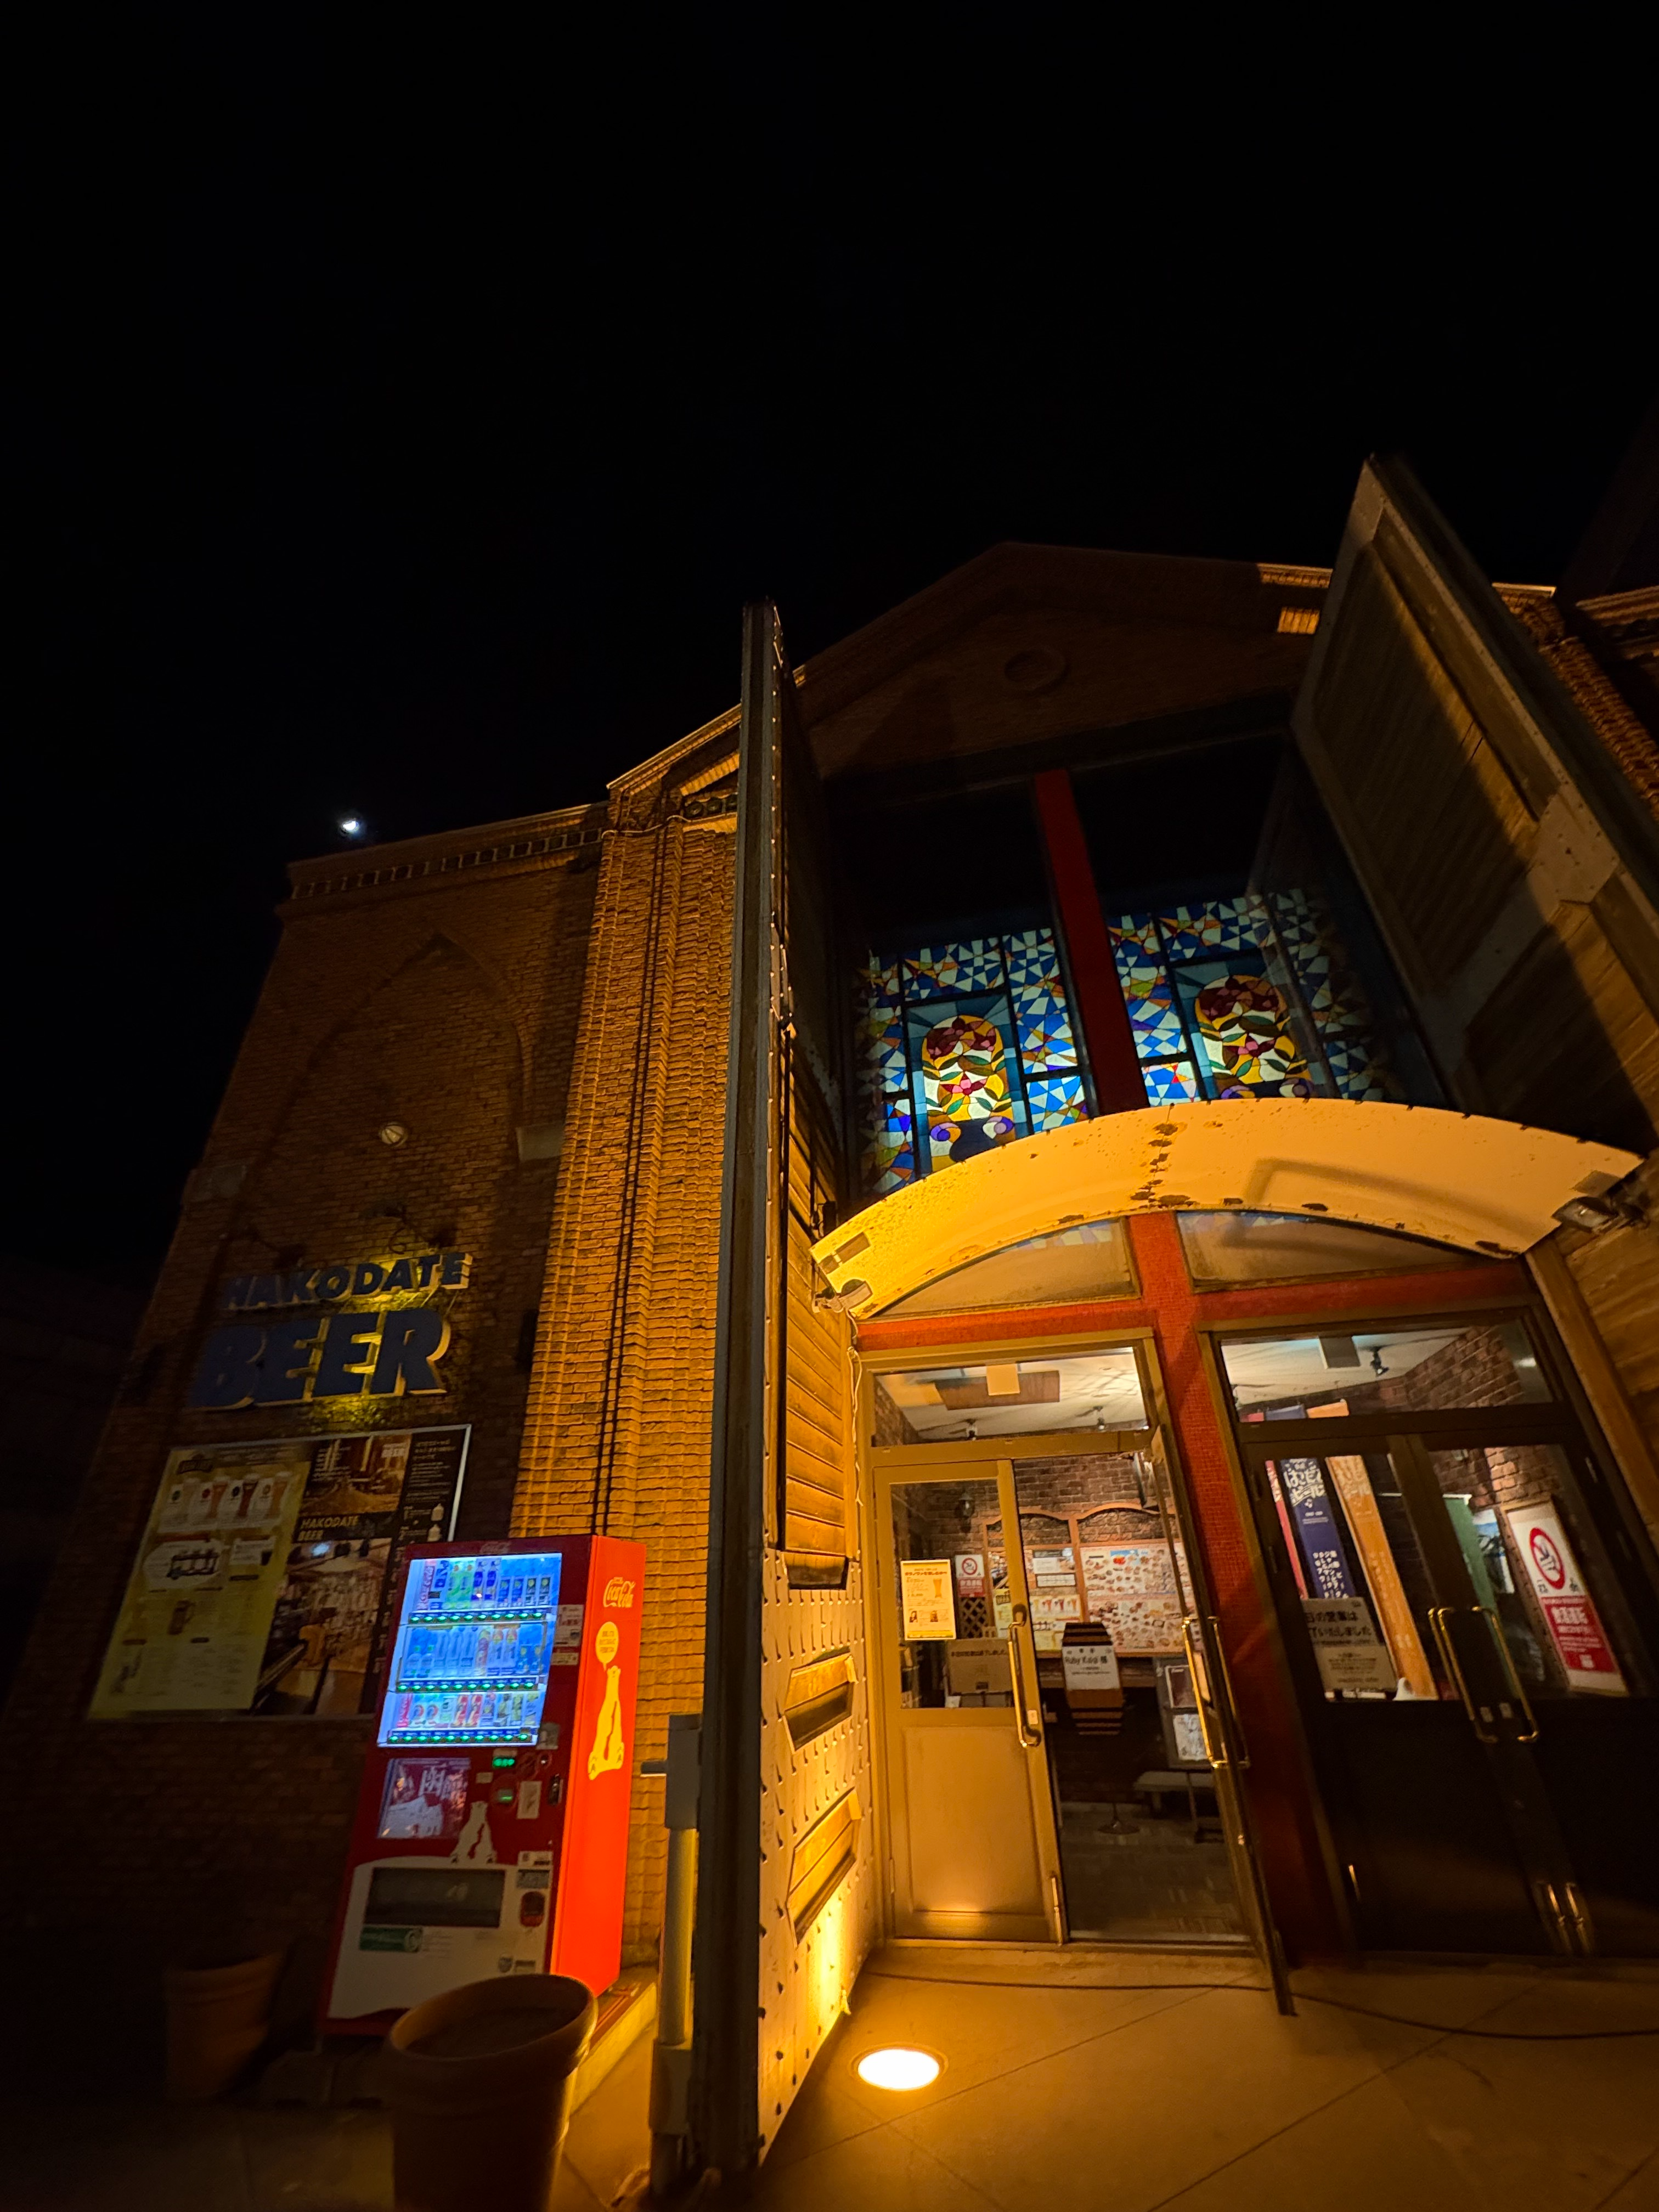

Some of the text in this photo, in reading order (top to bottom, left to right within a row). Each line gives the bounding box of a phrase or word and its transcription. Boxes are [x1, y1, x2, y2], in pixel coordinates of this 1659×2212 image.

[227, 1253, 473, 1308] HAKODATE
[187, 1310, 451, 1409] BEER
[298, 1530, 323, 1541] BEER
[301, 1516, 359, 1528] HAKODATE
